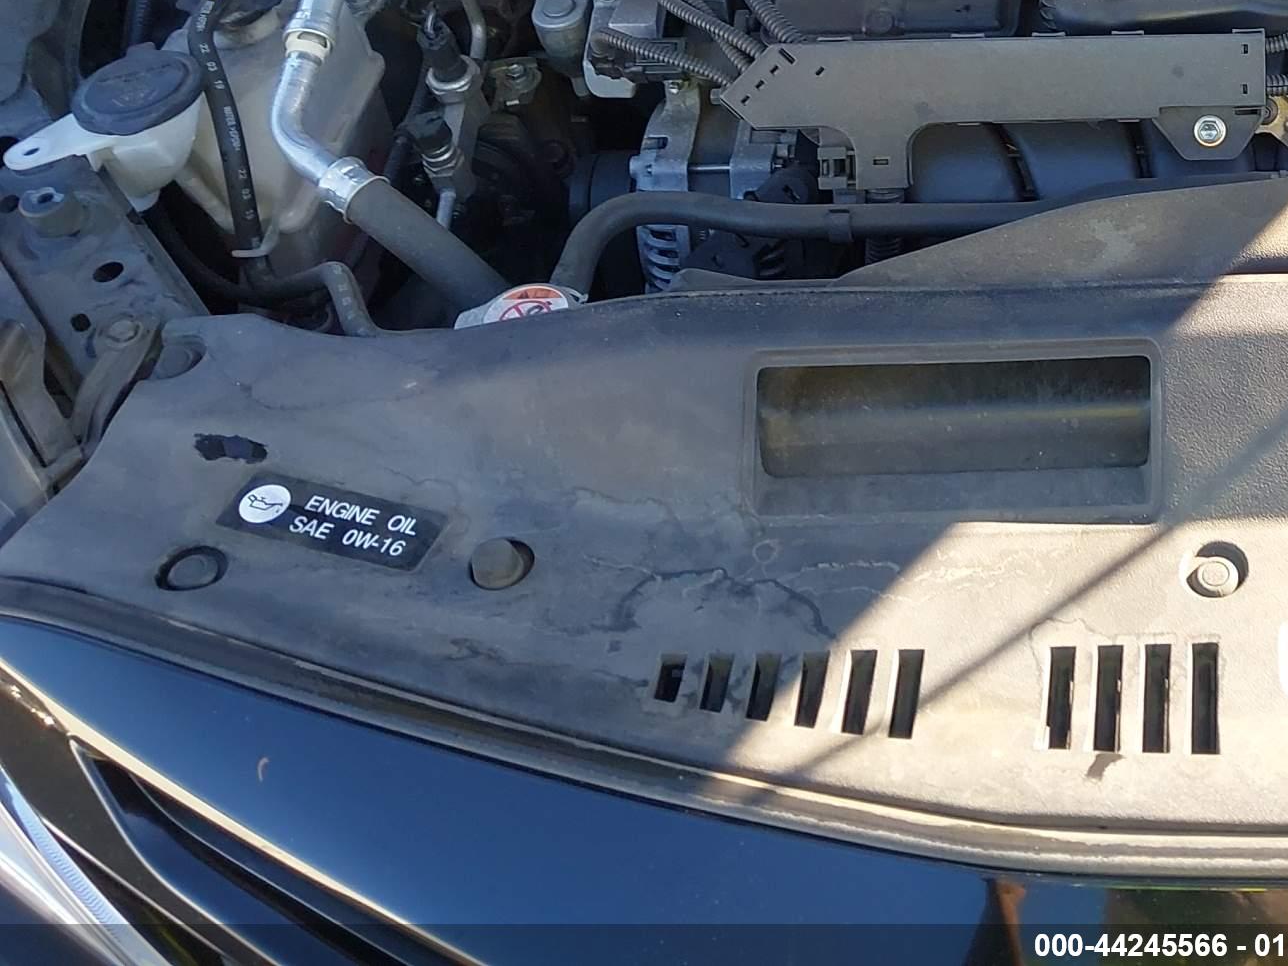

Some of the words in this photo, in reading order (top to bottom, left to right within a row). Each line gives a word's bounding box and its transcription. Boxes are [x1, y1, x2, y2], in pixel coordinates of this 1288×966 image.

[304, 495, 380, 526] ENGINE
[387, 514, 417, 536] OIL
[289, 516, 335, 540] SAE
[342, 530, 407, 557] 0W-16
